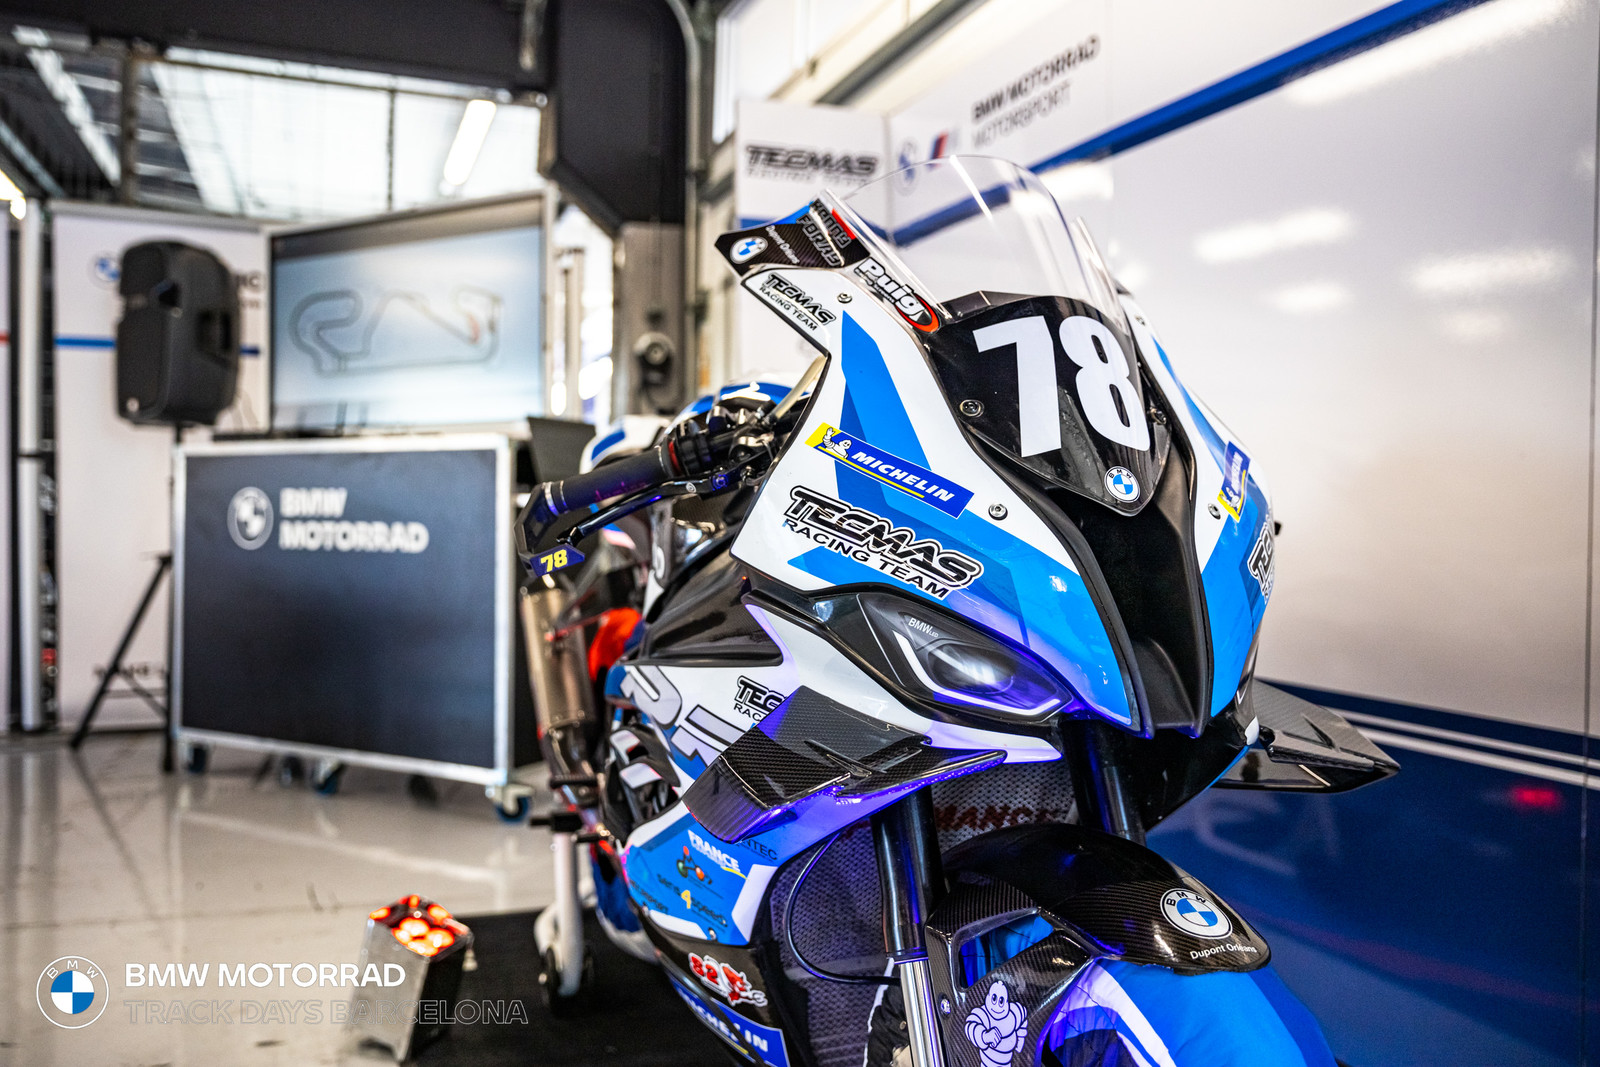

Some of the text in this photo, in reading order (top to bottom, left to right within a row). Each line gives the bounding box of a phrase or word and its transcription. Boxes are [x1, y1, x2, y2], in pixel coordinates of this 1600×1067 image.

[972, 34, 1100, 125] BMW MOTORRAD
[973, 77, 1071, 149] MOTORSPORT
[746, 145, 878, 177] TECMAS
[759, 286, 818, 330] RACING TEAM
[762, 272, 836, 325] TECMAS
[857, 257, 926, 321] Puig
[972, 315, 1151, 458] 78
[851, 451, 955, 502] MICHELIN
[279, 487, 348, 518] BMW
[279, 521, 429, 553] MOTORRAD
[783, 519, 949, 599] RACING TEAM
[784, 485, 984, 588] TECMAS
[540, 549, 568, 573] 78
[908, 617, 933, 634] BMW
[688, 829, 740, 872] FRANCE
[1190, 945, 1226, 960] Dupont
